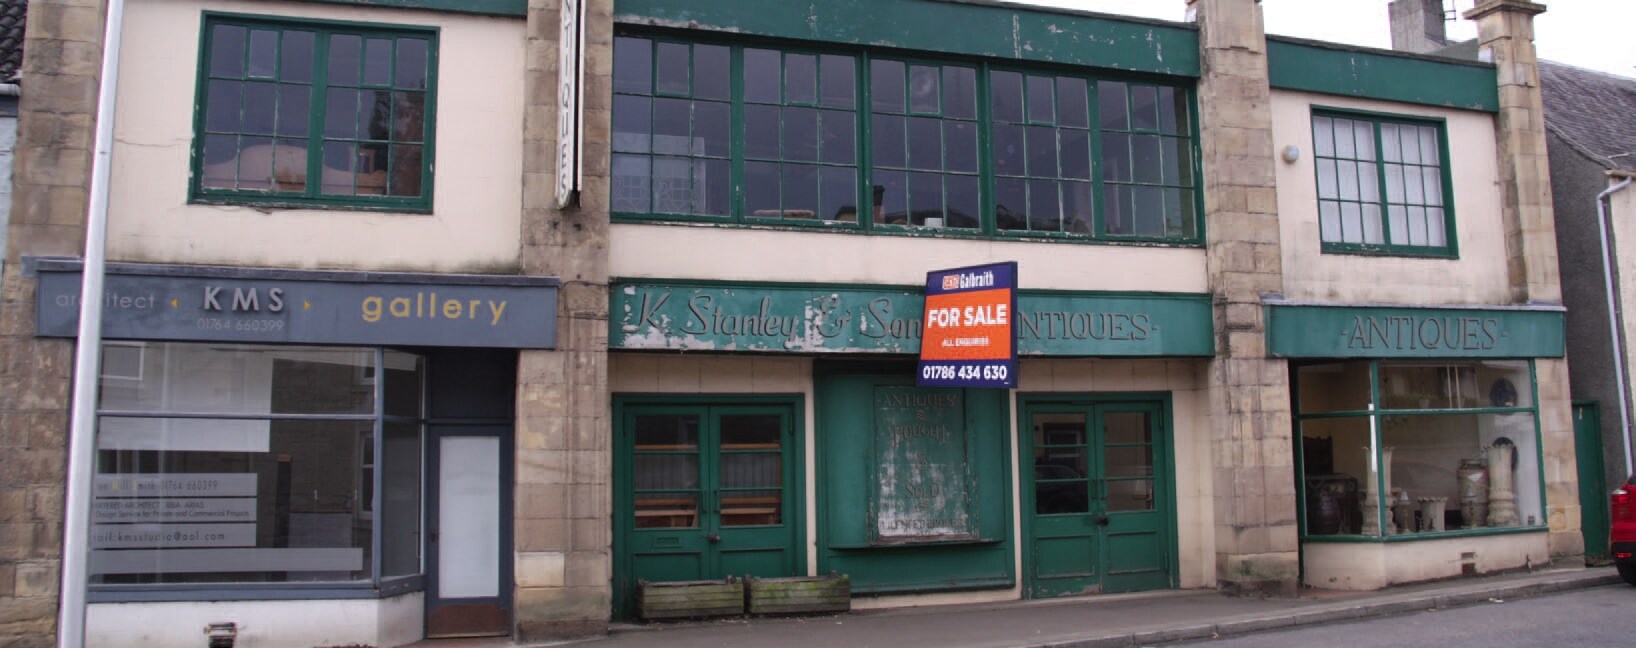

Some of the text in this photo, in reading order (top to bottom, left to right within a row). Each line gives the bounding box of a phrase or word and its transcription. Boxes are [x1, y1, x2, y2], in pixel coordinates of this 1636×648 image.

[960, 271, 994, 289] Galbraith
[55, 286, 508, 326] aritect KMS gallery
[635, 293, 669, 335] K
[680, 292, 800, 343] Stanley
[816, 294, 851, 340] &
[1017, 311, 1149, 342] NTIQUES
[928, 304, 1008, 328] FOR SALE
[196, 317, 284, 332] 01764 660399
[1347, 315, 1498, 350] ANTIQUES
[942, 339, 954, 347] ALL
[923, 365, 1007, 380] 01786 434 630
[881, 392, 956, 408] ANTIQUES
[186, 480, 218, 490] 660399
[176, 510, 188, 518] and
[189, 510, 225, 518] Commercial
